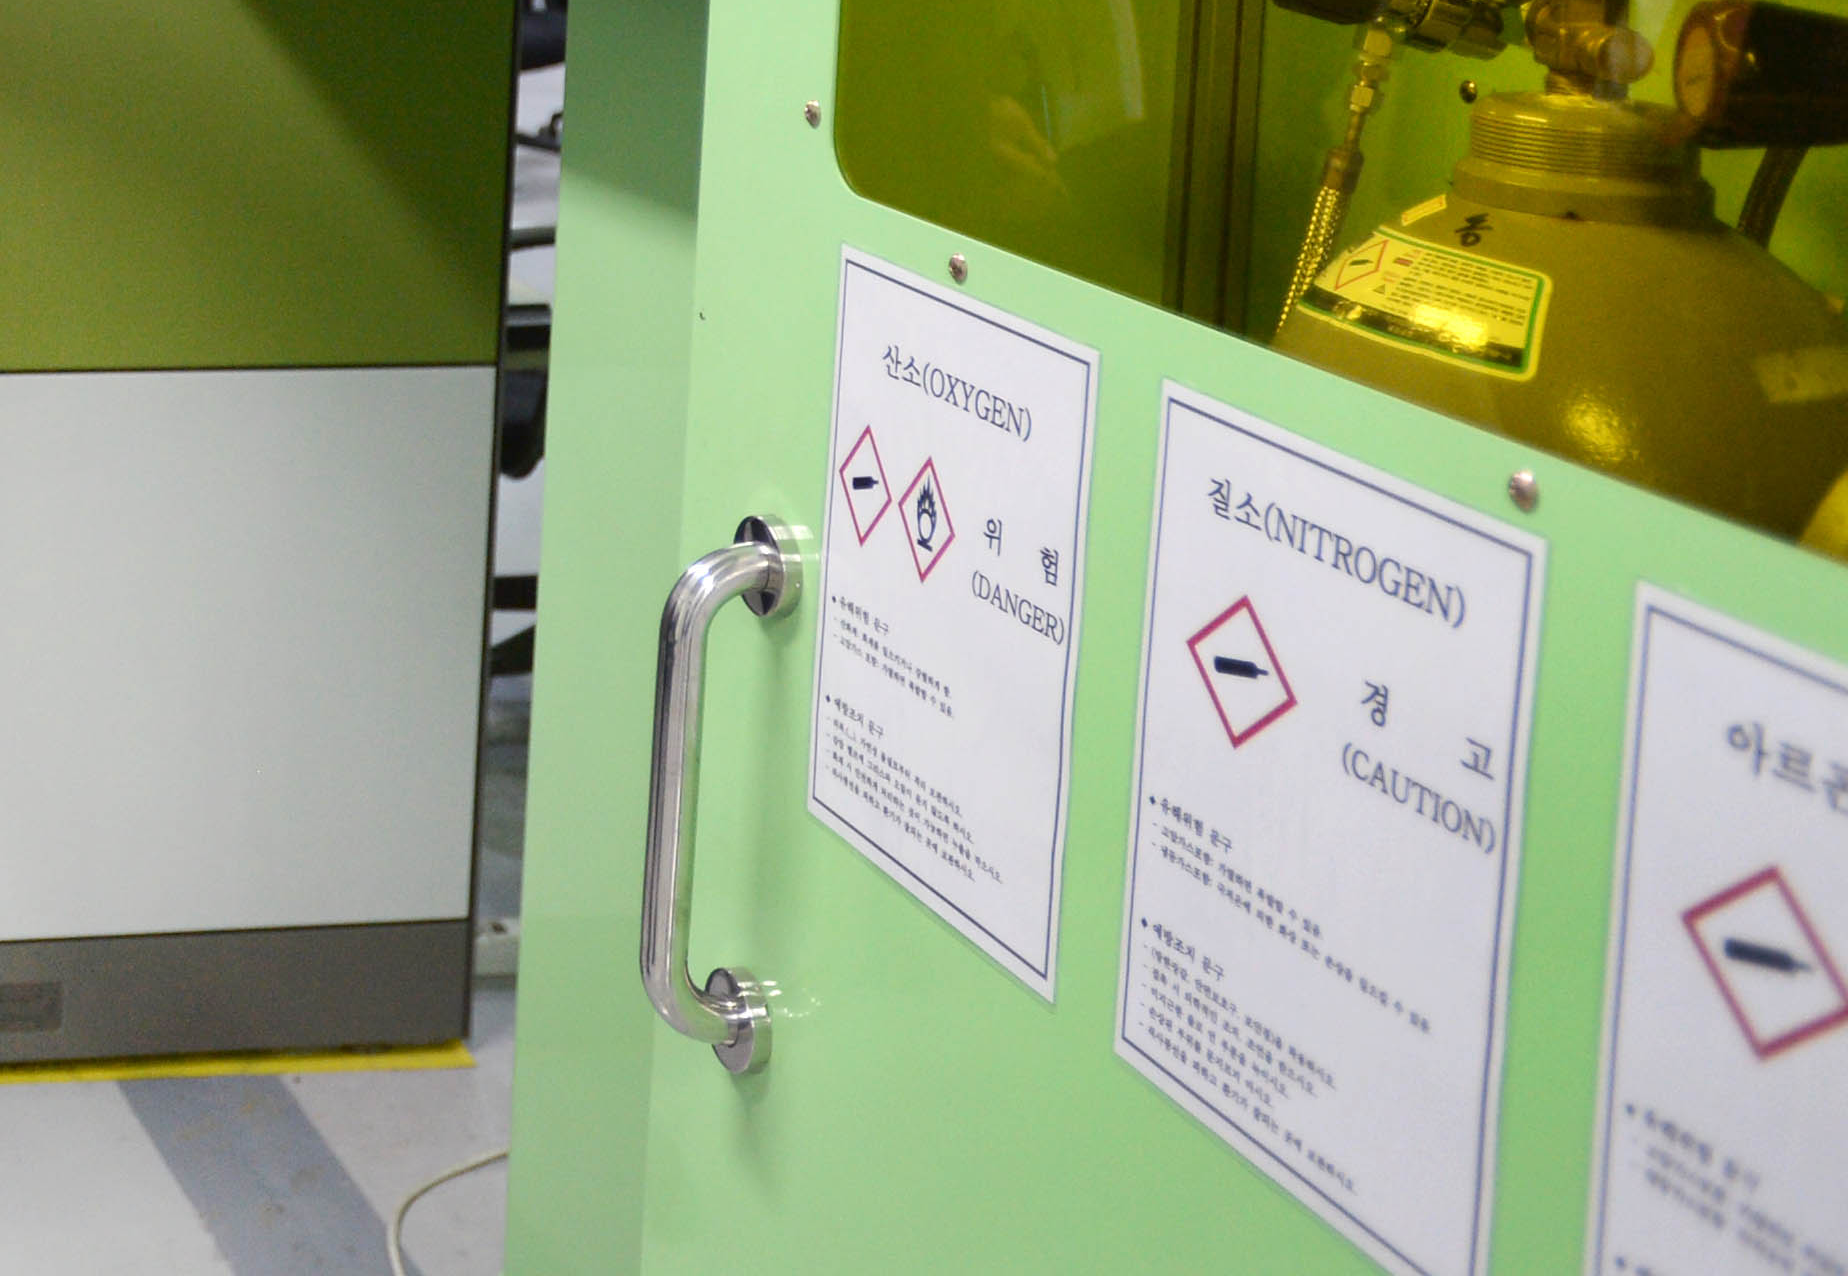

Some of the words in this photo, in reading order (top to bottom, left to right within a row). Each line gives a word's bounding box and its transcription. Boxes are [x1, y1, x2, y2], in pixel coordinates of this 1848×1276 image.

[882, 344, 1032, 443] 산소(OXYGEN)
[983, 517, 1004, 557] 위
[1040, 547, 1060, 588] 험
[1206, 476, 1465, 630] 질소(NITROGEN)
[972, 569, 1064, 647] (DANGER)
[1360, 679, 1390, 729] 경
[1462, 735, 1496, 781] 고
[1342, 740, 1495, 854] (CAUTION)
